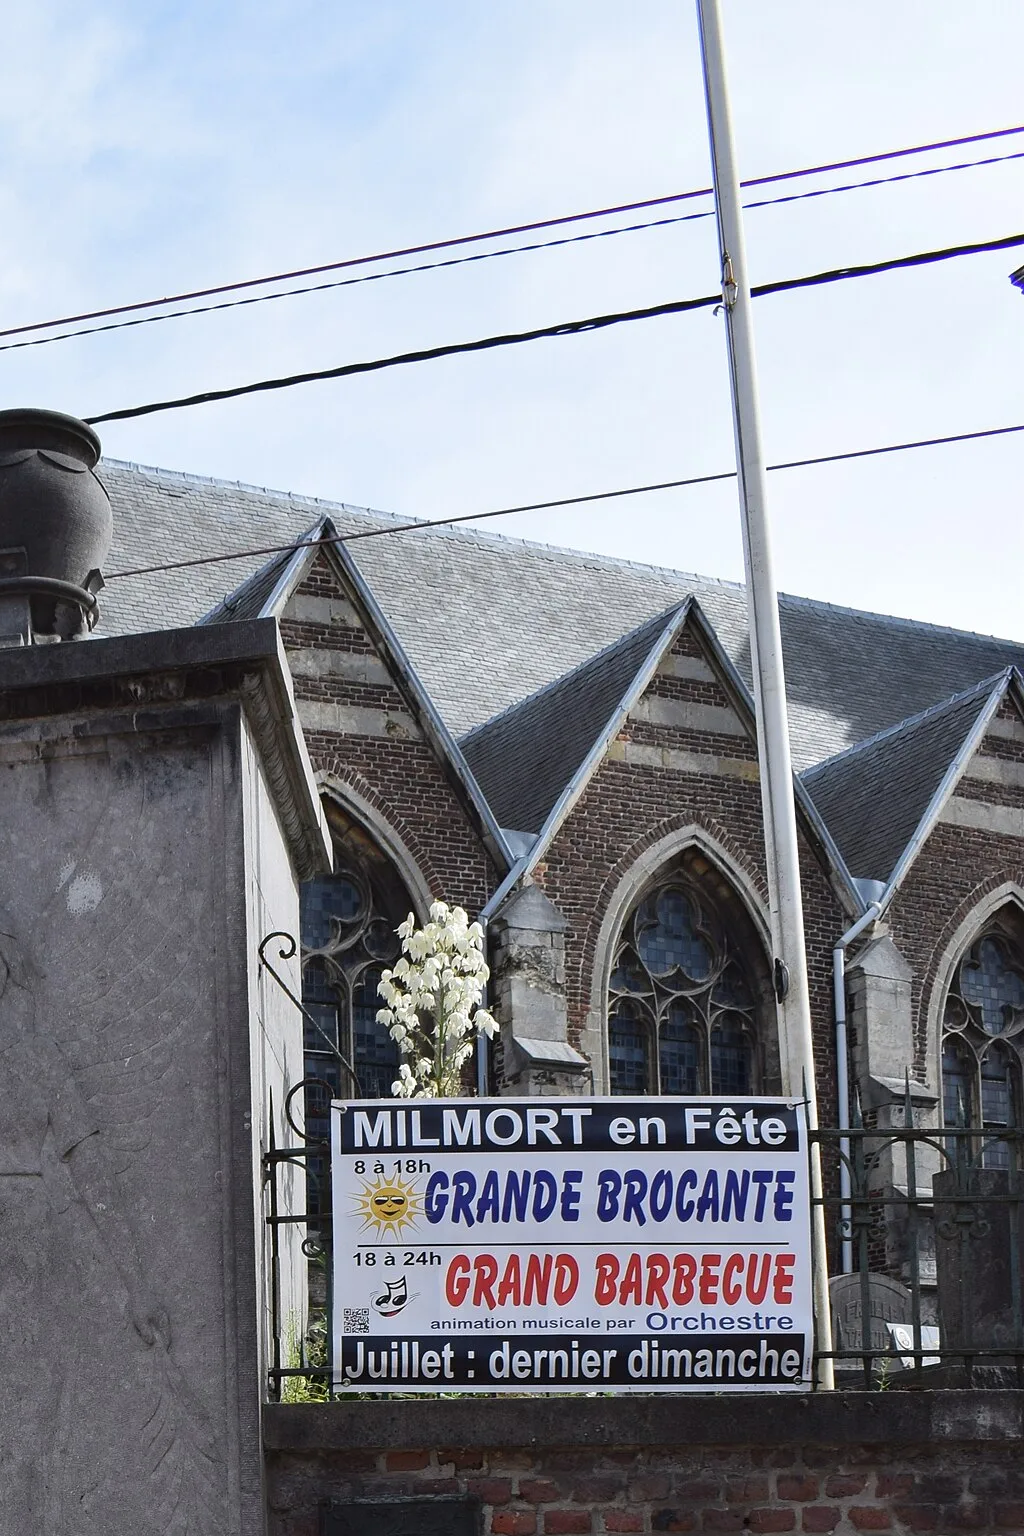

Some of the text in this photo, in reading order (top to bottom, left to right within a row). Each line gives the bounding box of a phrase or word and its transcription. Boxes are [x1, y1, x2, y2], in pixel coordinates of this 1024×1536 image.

[354, 1108, 787, 1147] MILMORT en Fête
[354, 1158, 431, 1174] 8 à 18h
[425, 1169, 795, 1227] GRANDE BROCANTE
[352, 1251, 442, 1266] 18 à 24h
[445, 1253, 795, 1310] GRAND BARBECUE
[430, 1312, 793, 1331] animation musicale par Orchestre
[345, 1341, 454, 1380] Juillet
[489, 1341, 617, 1379] dernier
[628, 1339, 800, 1378] dimanche
